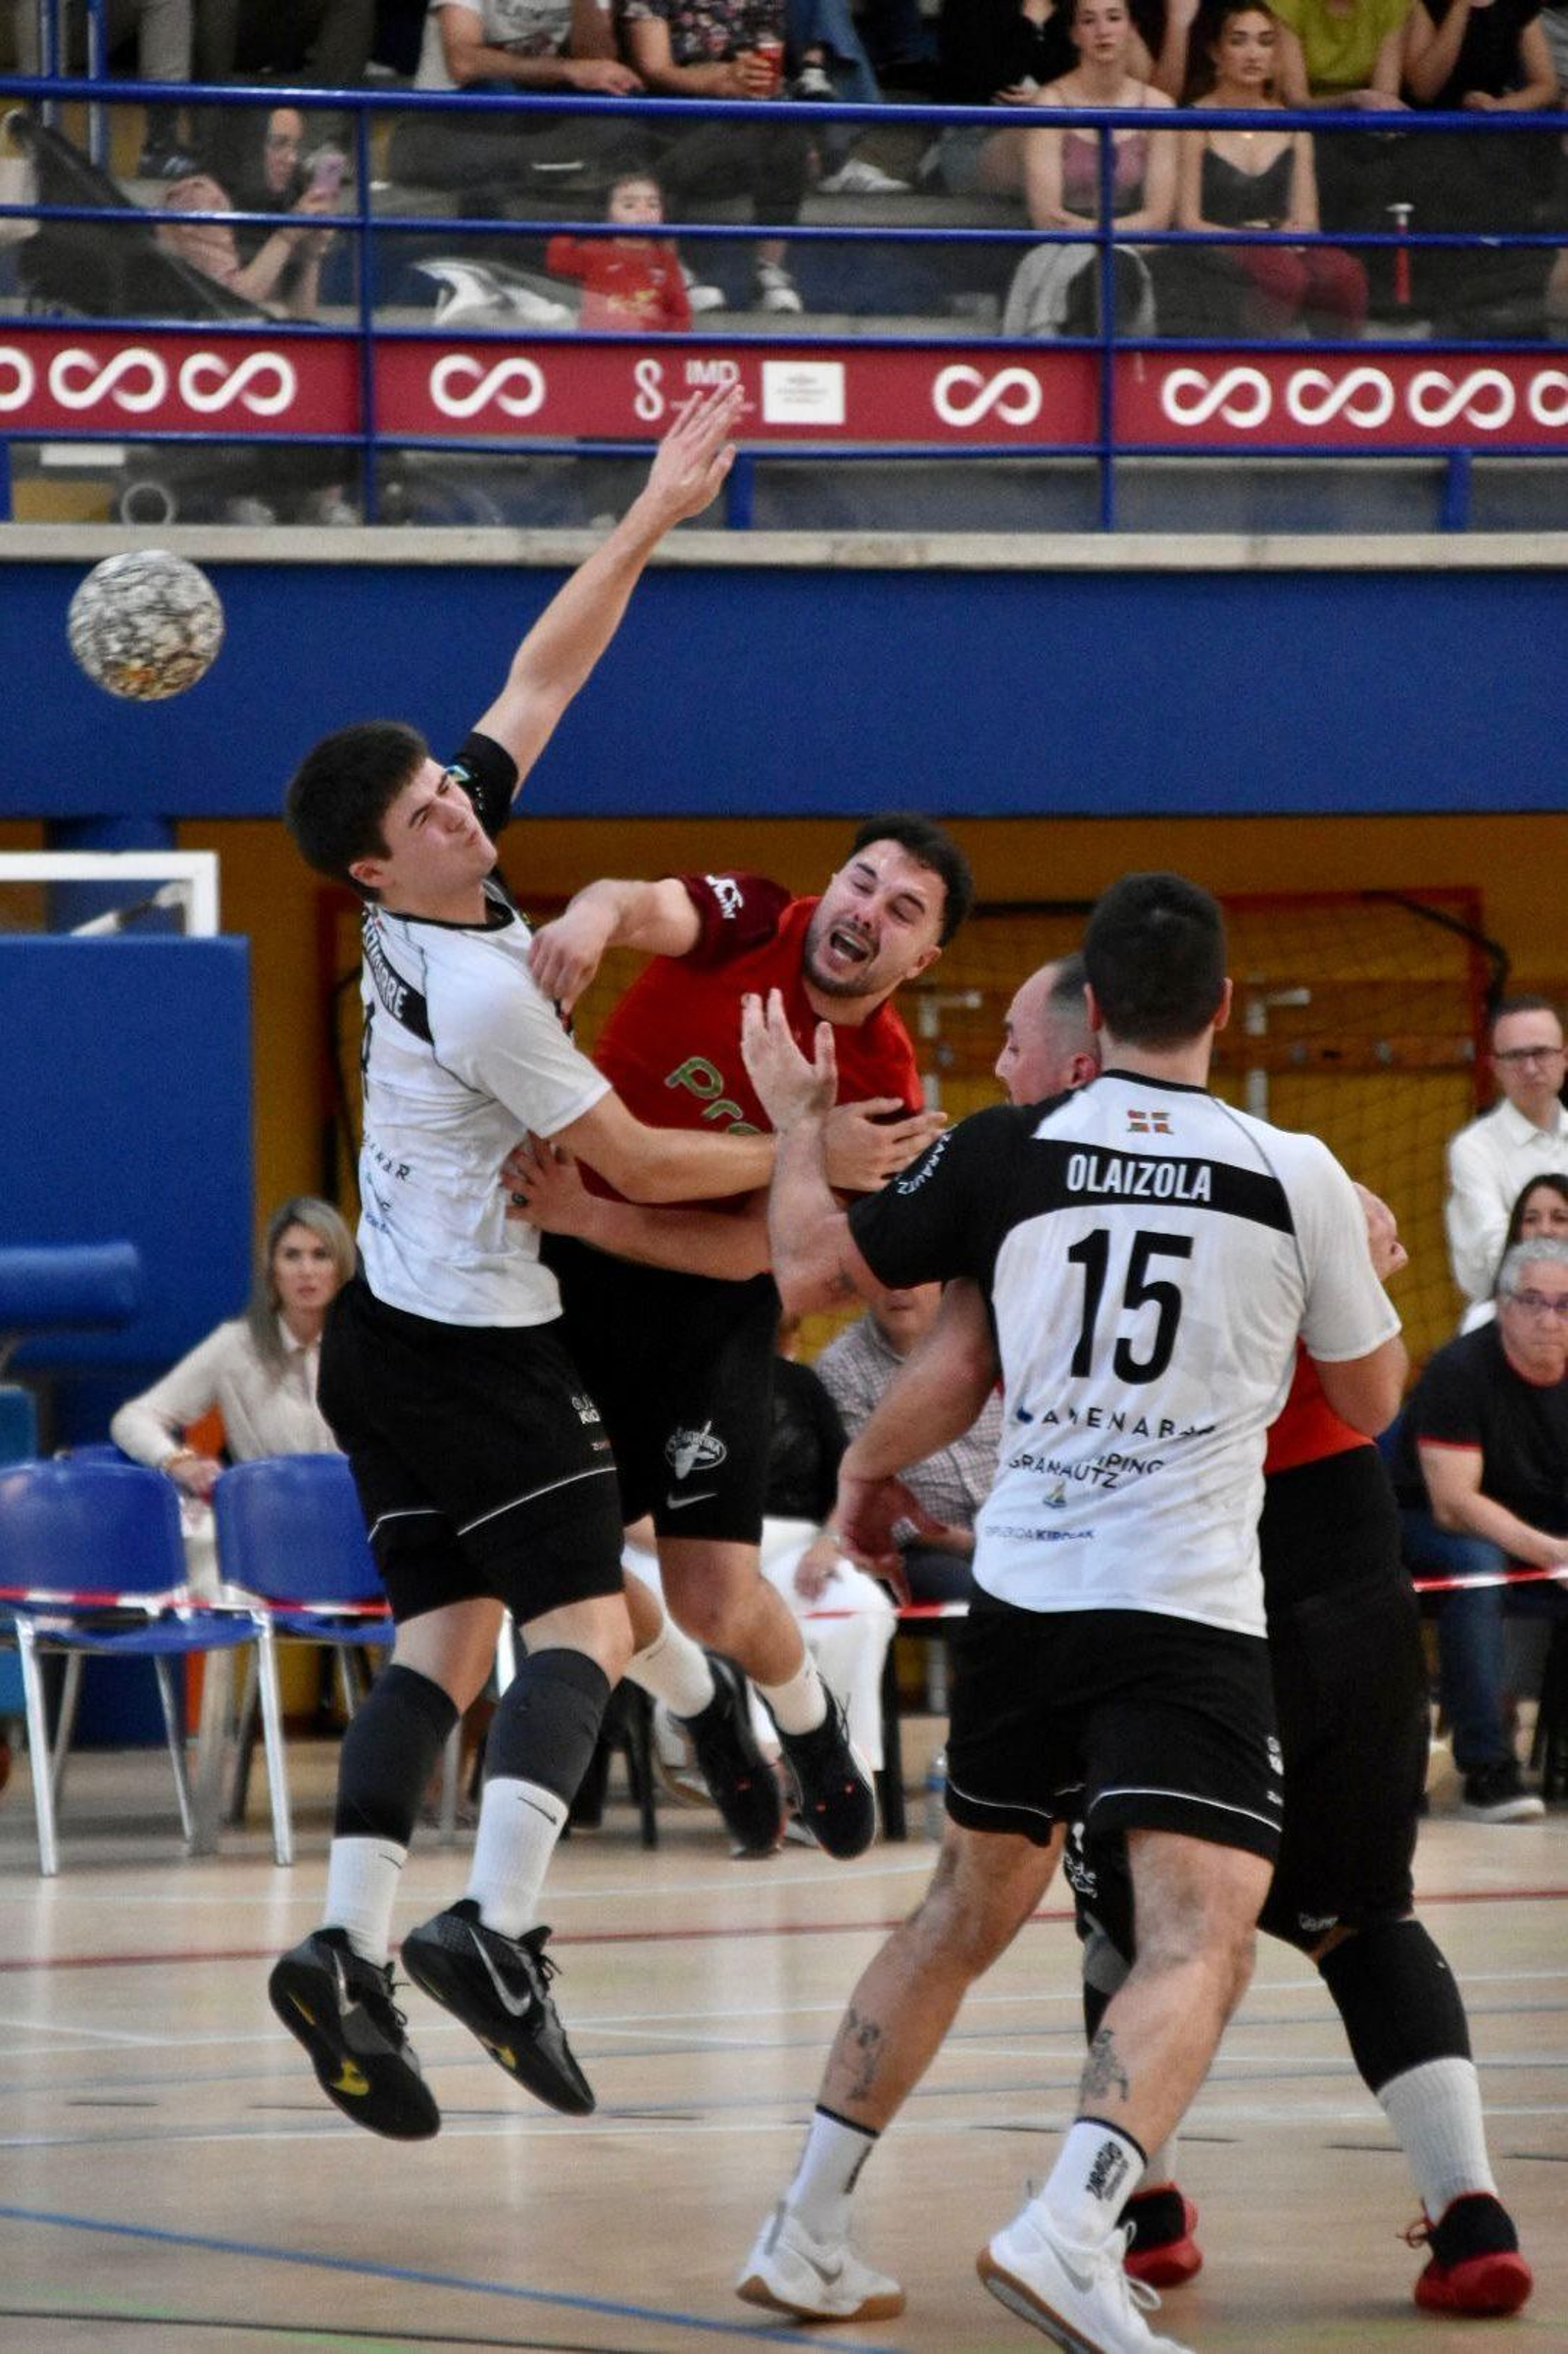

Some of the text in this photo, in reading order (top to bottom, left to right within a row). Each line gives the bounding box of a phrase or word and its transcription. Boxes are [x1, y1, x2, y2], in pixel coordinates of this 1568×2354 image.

[686, 360, 740, 384] IMD
[1066, 1153, 1212, 1202] OLAIZOLA
[1067, 1228, 1194, 1385] 15
